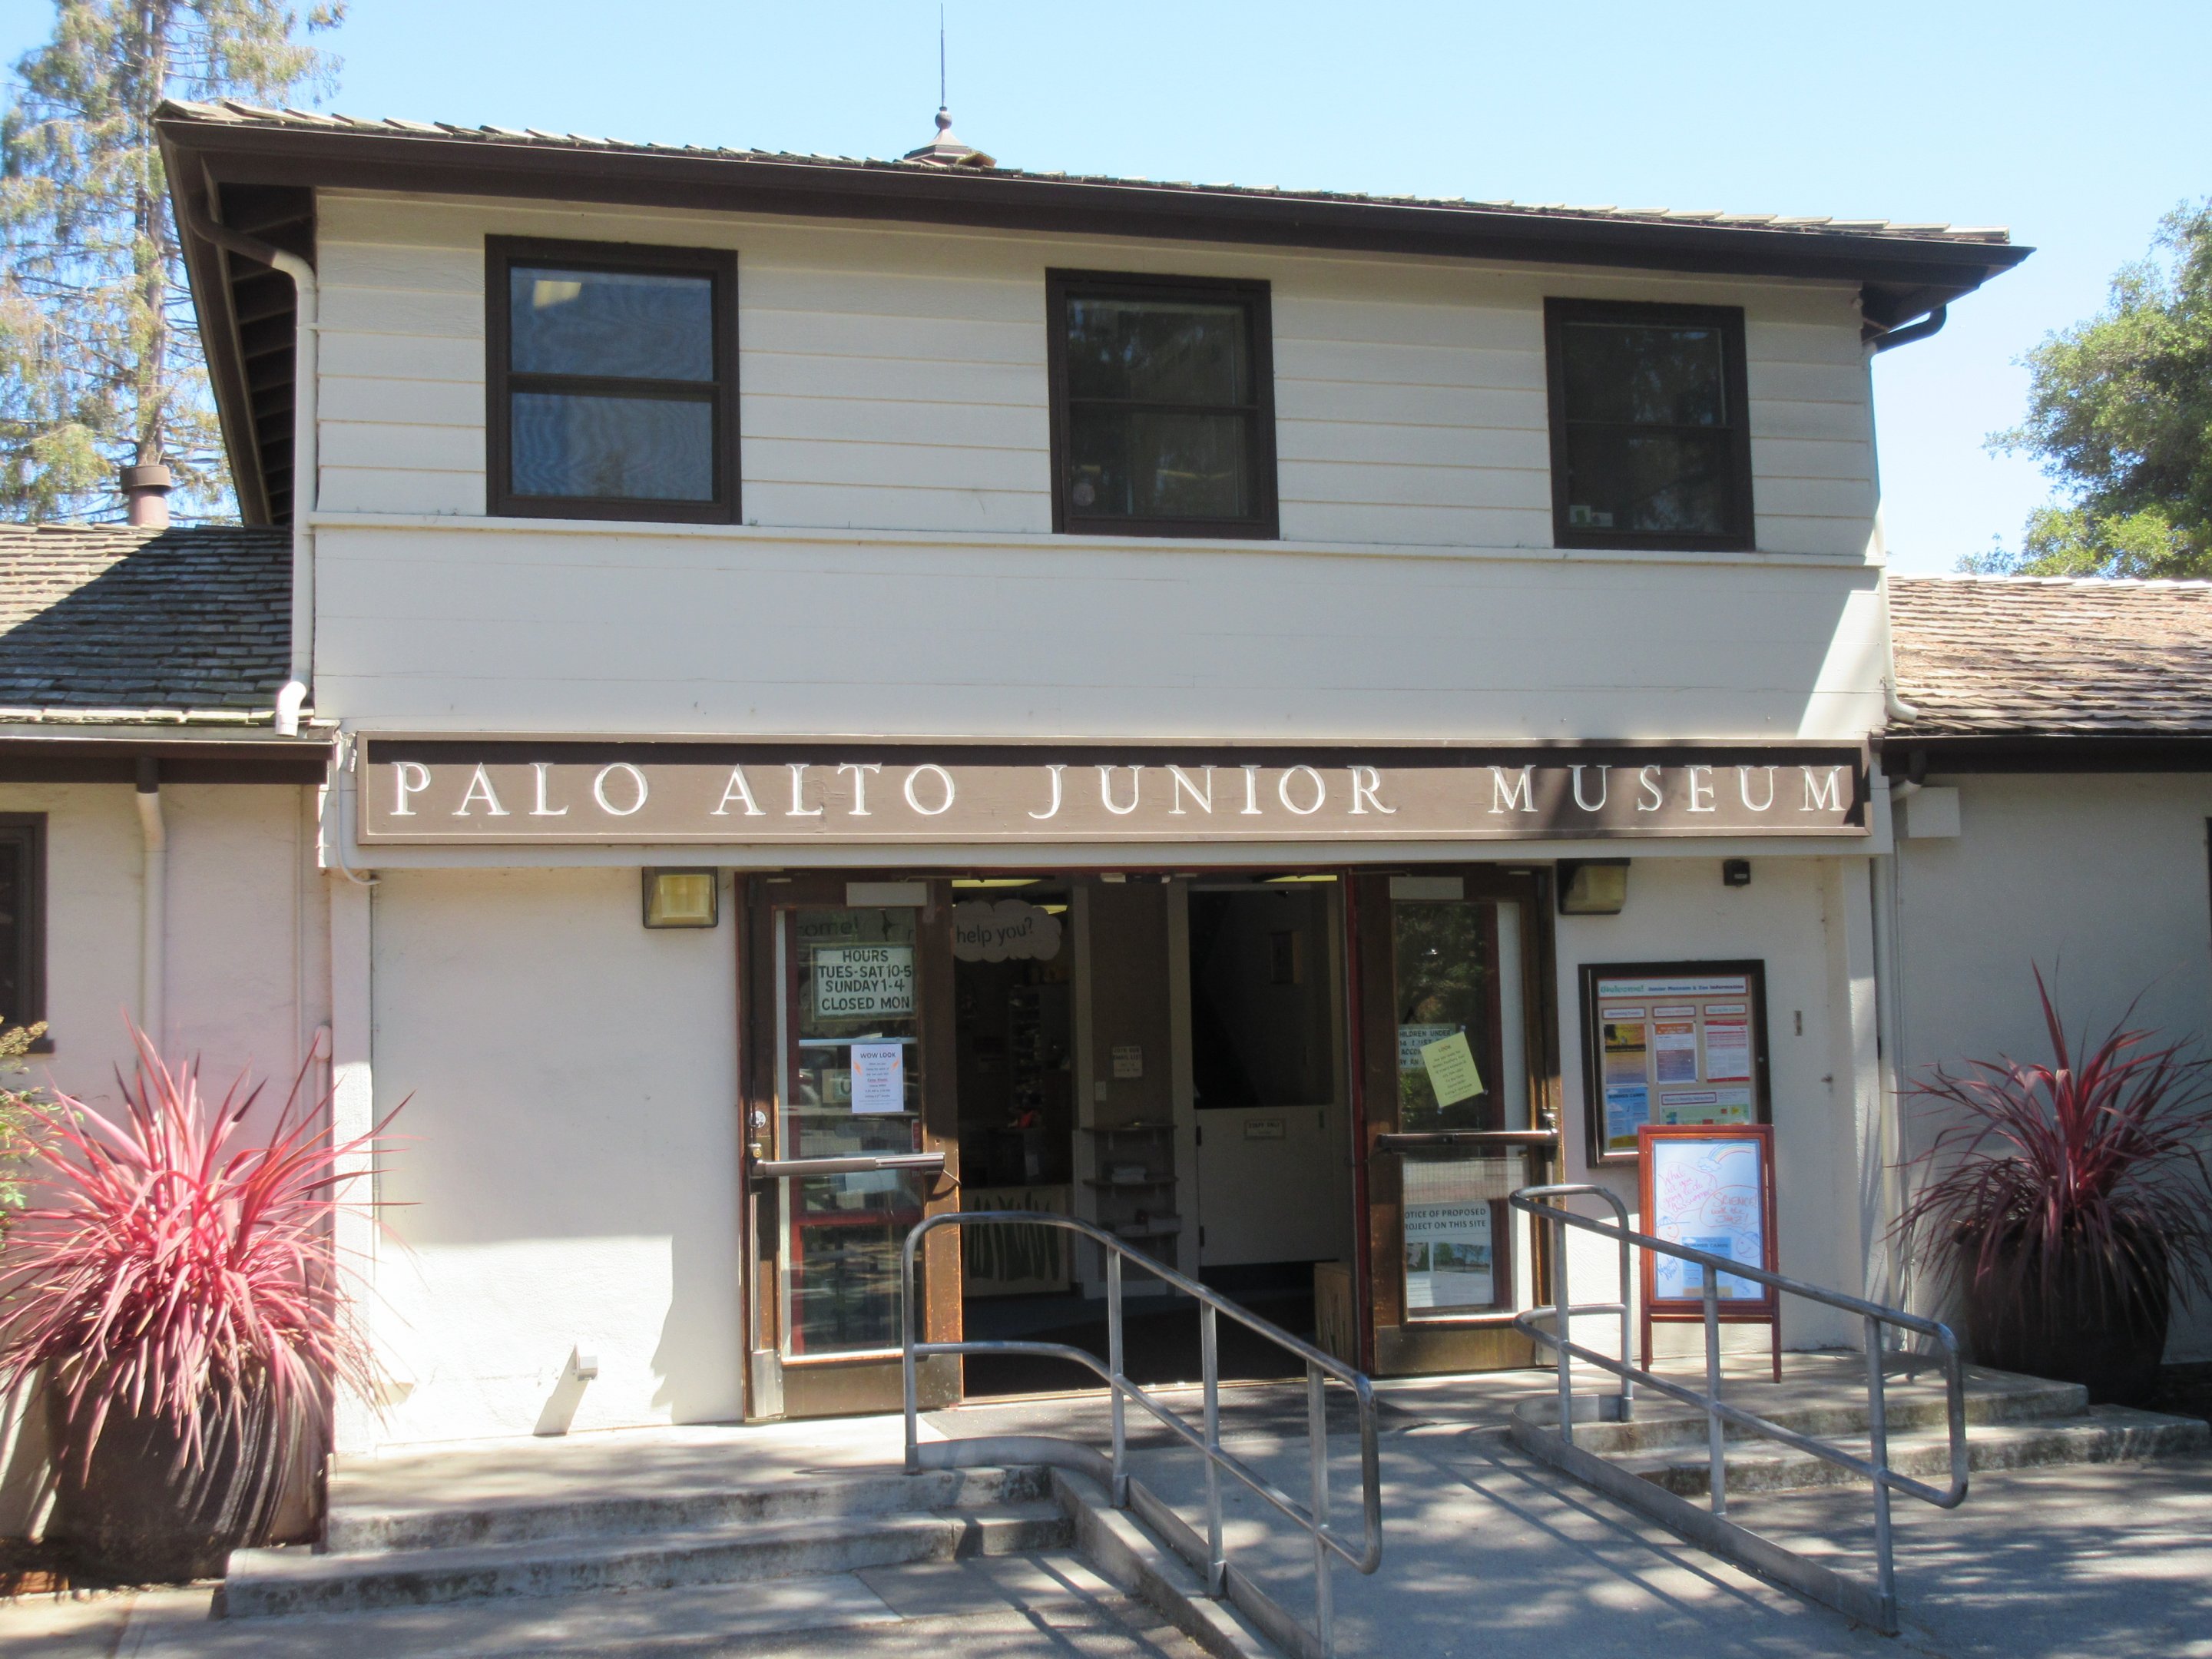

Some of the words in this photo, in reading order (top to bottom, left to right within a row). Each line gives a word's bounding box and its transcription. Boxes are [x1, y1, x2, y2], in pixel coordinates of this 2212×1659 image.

[390, 761, 648, 816] PALO
[710, 761, 956, 816] ALTO
[1028, 763, 1397, 820] JUNIOR
[1487, 764, 1852, 814] MUSEUM
[957, 925, 992, 947] help
[997, 917, 1033, 946] you?
[843, 950, 889, 962] HOURS
[887, 965, 912, 978] 10-5
[826, 980, 879, 992] SUNDAY
[882, 979, 905, 992] 1-4
[822, 998, 874, 1010] CLOSED
[881, 996, 909, 1009] MON
[1405, 1210, 1426, 1219] OTICE
[1442, 1208, 1486, 1217] PROPOSED
[1405, 1222, 1432, 1230] ROJECT
